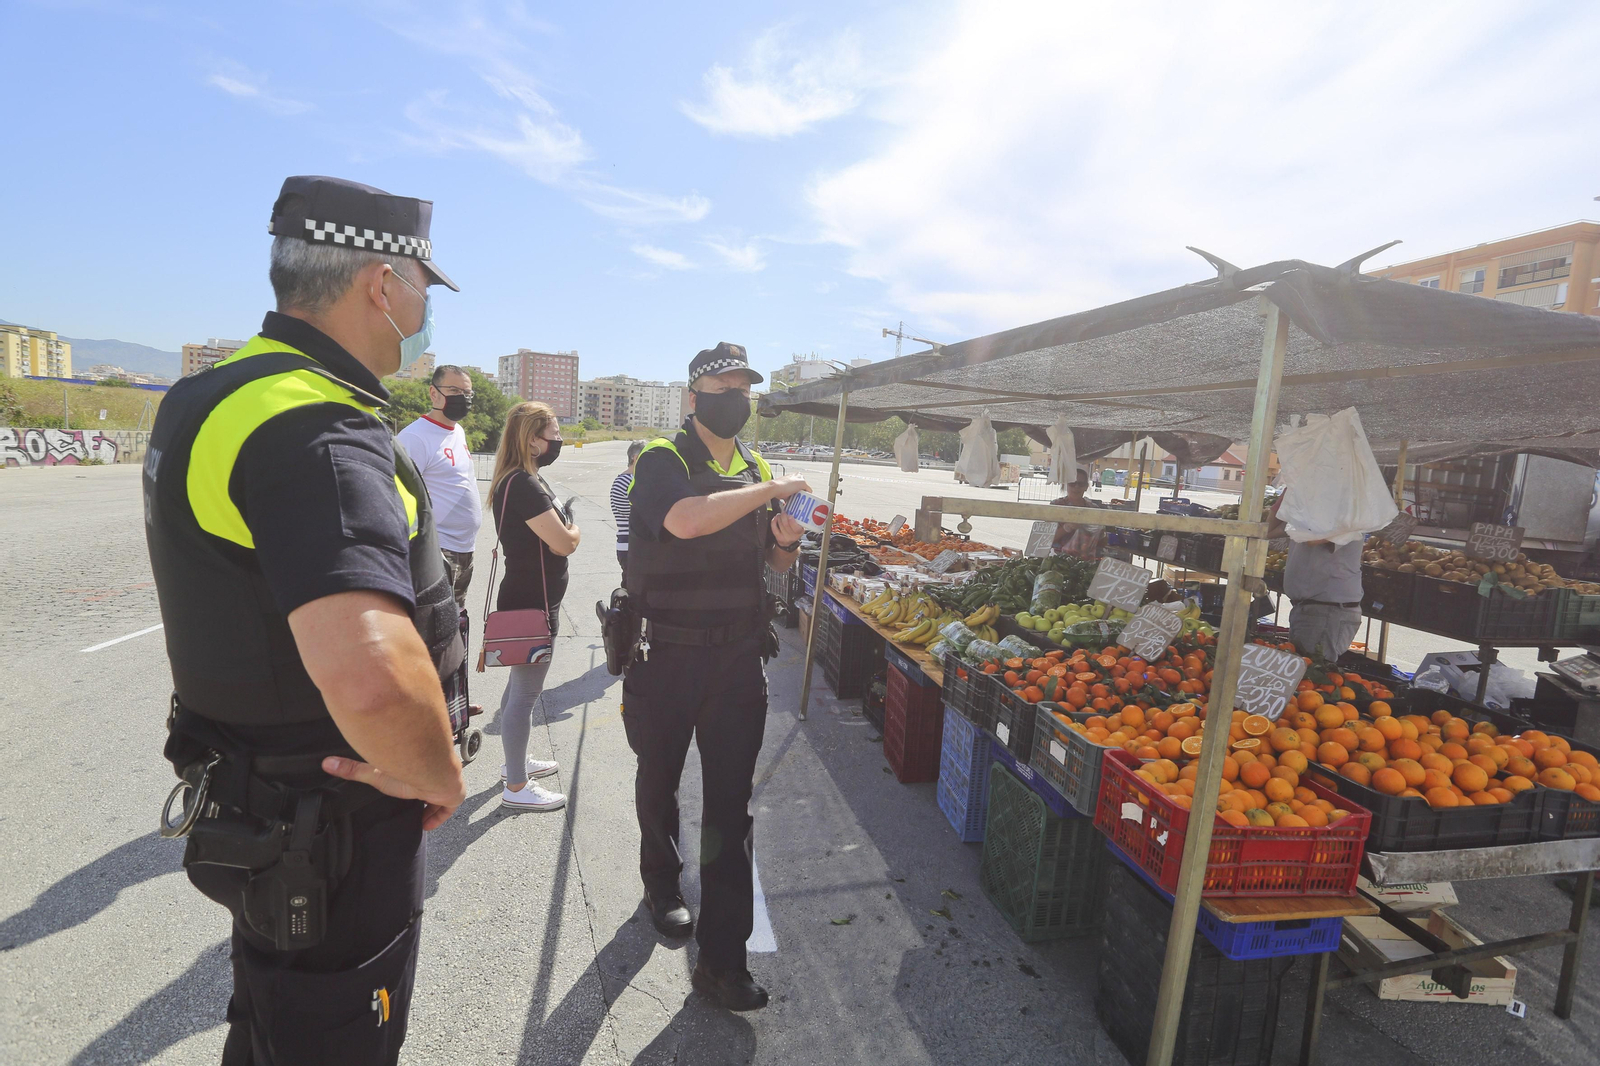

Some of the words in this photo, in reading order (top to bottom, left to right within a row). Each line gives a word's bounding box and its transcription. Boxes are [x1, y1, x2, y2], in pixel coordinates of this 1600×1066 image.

[1474, 522, 1514, 539] PAPA
[1100, 556, 1150, 587] OFERTA
[1121, 620, 1142, 642] 2
[1240, 644, 1301, 677] ZUMO
